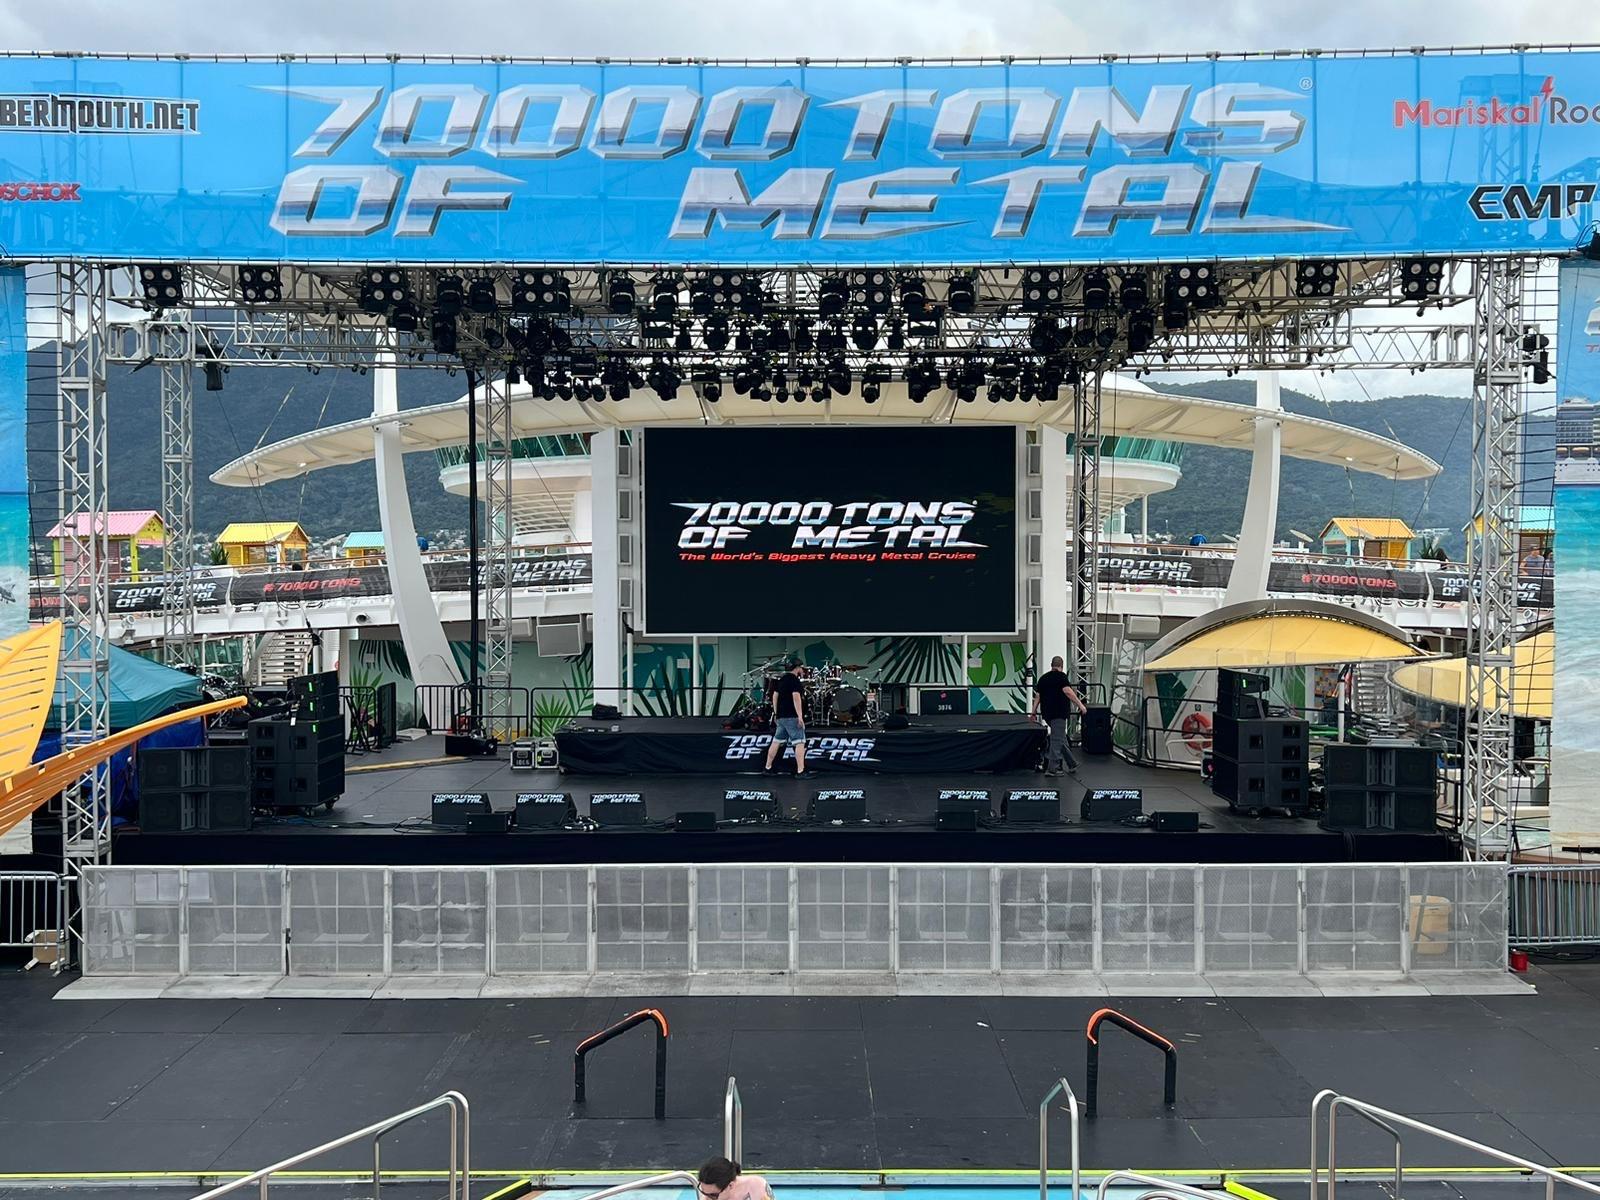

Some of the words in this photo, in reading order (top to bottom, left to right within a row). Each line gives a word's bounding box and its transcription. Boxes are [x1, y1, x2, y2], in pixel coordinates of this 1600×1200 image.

[1394, 97, 1540, 127] Mariskal
[269, 165, 527, 237] OF
[668, 161, 1352, 240] METAL
[678, 526, 752, 549] OF
[791, 525, 990, 549] METAL
[679, 553, 705, 561] The
[710, 552, 764, 561] World's
[767, 552, 825, 562] Biggest
[829, 552, 876, 562] Heavy
[881, 552, 924, 561] Metal
[927, 552, 977, 561] Cruise
[512, 568, 592, 583] METAL
[1120, 568, 1199, 582] METAL
[115, 598, 145, 608] OF
[725, 747, 762, 760] OF
